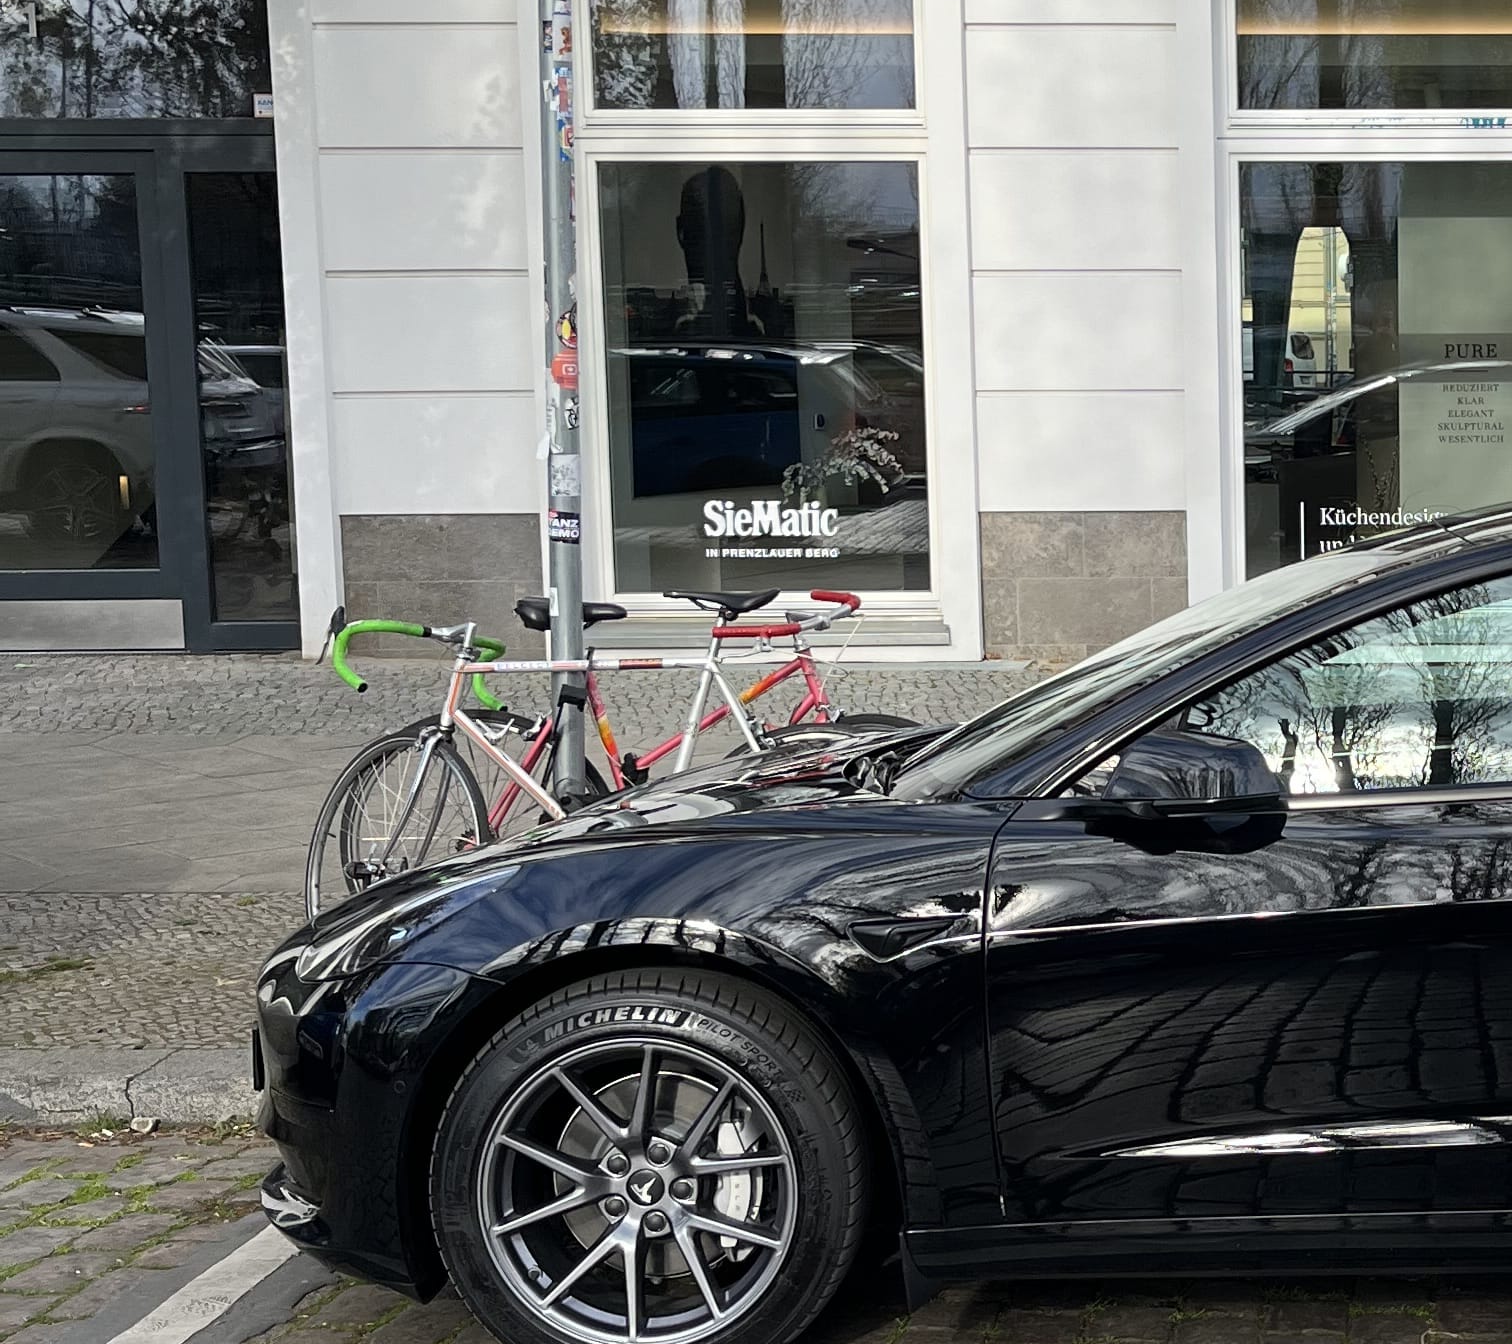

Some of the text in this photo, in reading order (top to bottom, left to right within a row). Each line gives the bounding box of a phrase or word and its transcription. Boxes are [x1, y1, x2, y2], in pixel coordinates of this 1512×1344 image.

[1444, 343, 1498, 358] PURE
[1442, 383, 1499, 392] REDUZIERT
[1457, 396, 1485, 405] KLAR
[1447, 409, 1495, 418] ELEGANT
[1437, 422, 1504, 431] SKULPTURAL
[1438, 435, 1504, 443] WESENTLICH
[703, 499, 839, 537] SieMatic
[705, 548, 840, 558] IN PRENZLAUER BERG
[544, 1006, 682, 1042] MICHELIN
[697, 1018, 741, 1042] PILOT
[740, 1041, 784, 1079] SPORT
